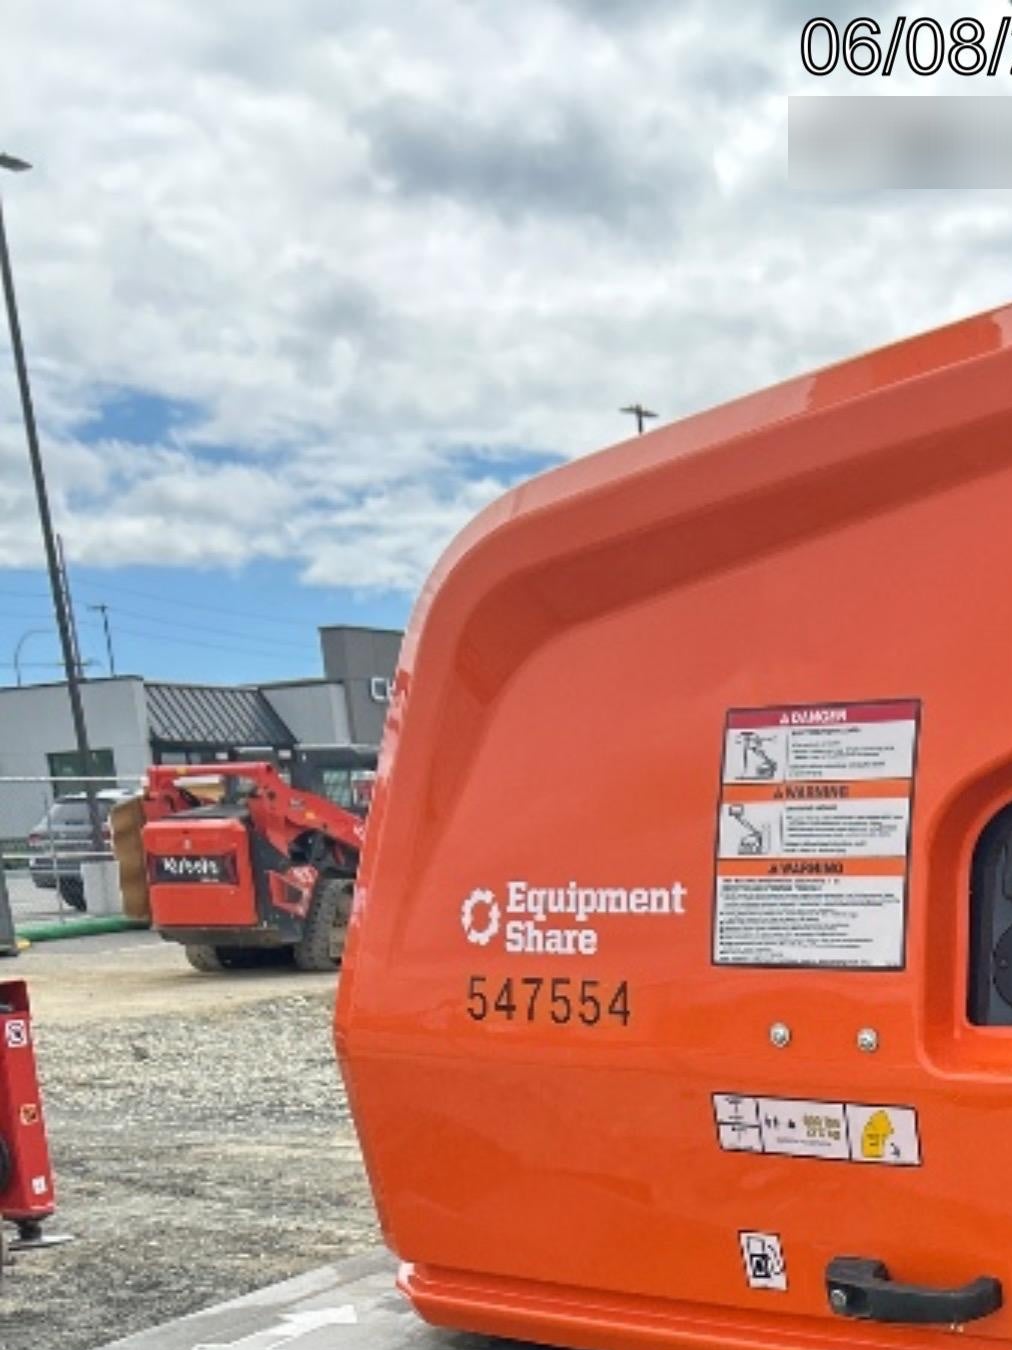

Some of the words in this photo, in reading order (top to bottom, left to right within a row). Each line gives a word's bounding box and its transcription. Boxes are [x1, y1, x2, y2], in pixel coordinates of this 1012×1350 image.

[784, 785, 850, 799] WARNING
[780, 862, 844, 876] WARNING
[506, 880, 688, 922] Equipment
[506, 920, 598, 955] Share
[467, 974, 631, 1027] 547554
